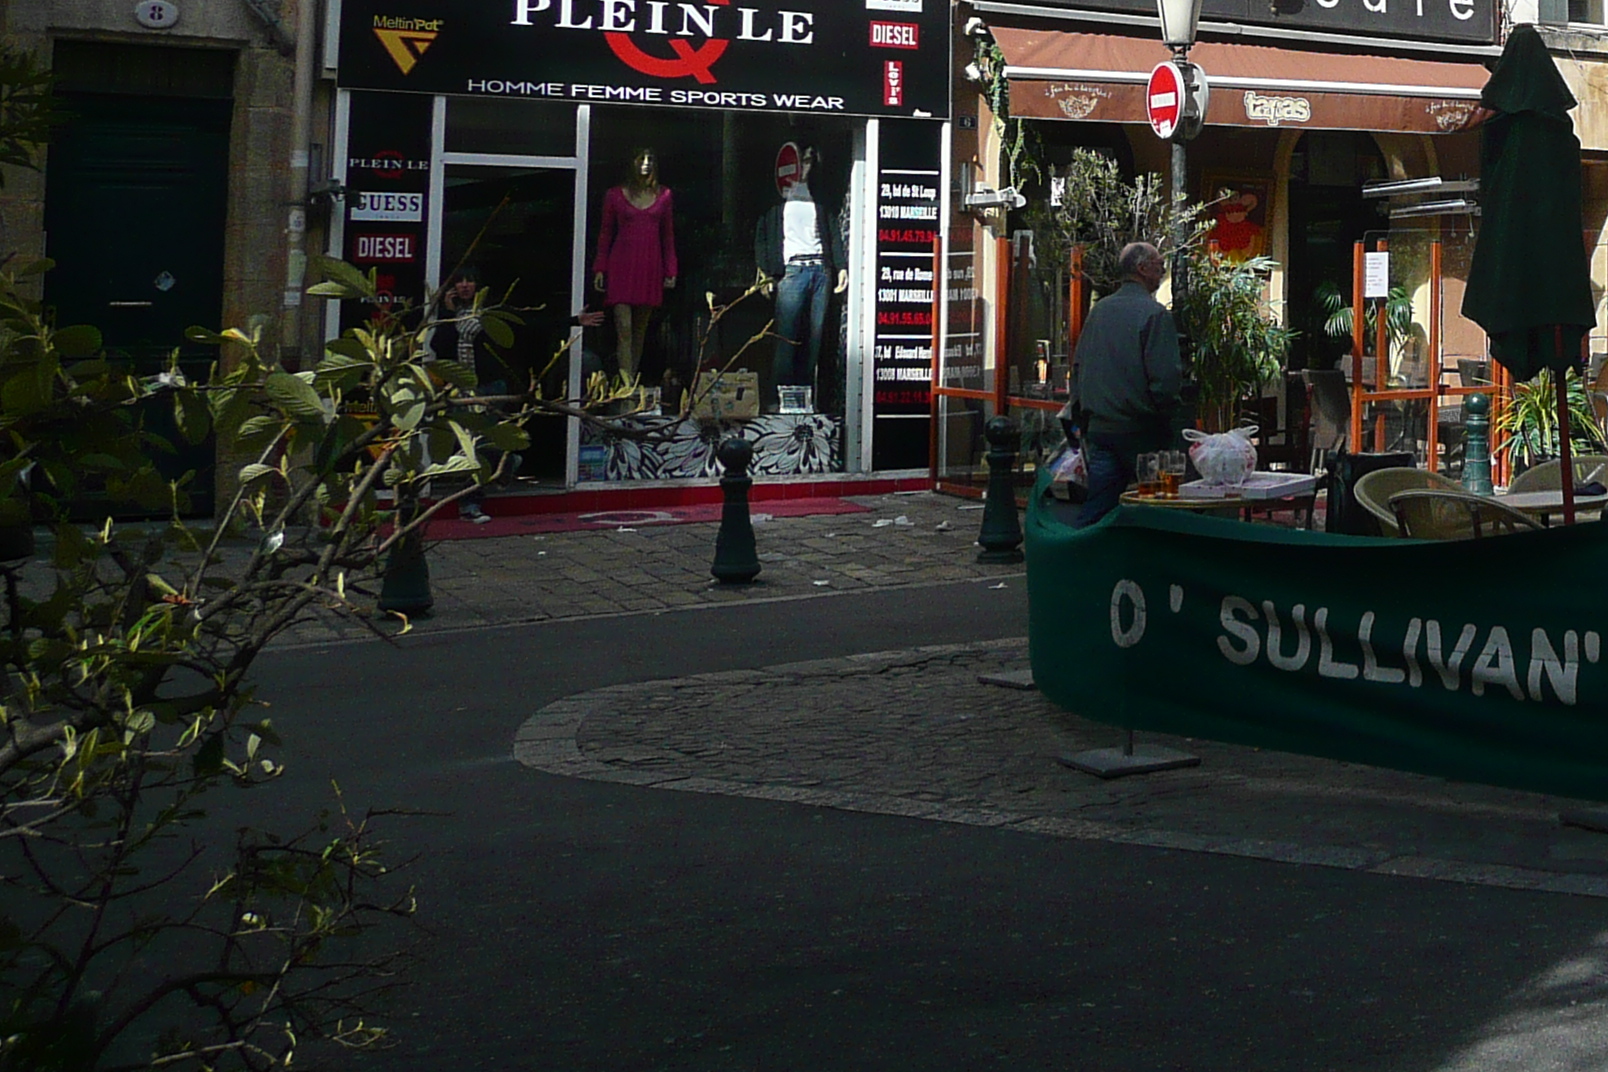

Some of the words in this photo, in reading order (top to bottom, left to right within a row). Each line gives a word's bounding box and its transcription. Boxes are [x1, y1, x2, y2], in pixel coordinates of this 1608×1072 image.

[150, 5, 164, 21] 8
[736, 7, 814, 44] LE
[872, 24, 917, 46] DIESEL
[468, 79, 565, 97] HOMME
[571, 84, 663, 102] FEMME
[670, 90, 767, 107] SPORTS
[773, 94, 845, 110] WEAR
[1244, 90, 1311, 127] tapas
[350, 158, 403, 170] PLEIN
[407, 161, 429, 170] LE
[358, 237, 413, 258] DIESEL
